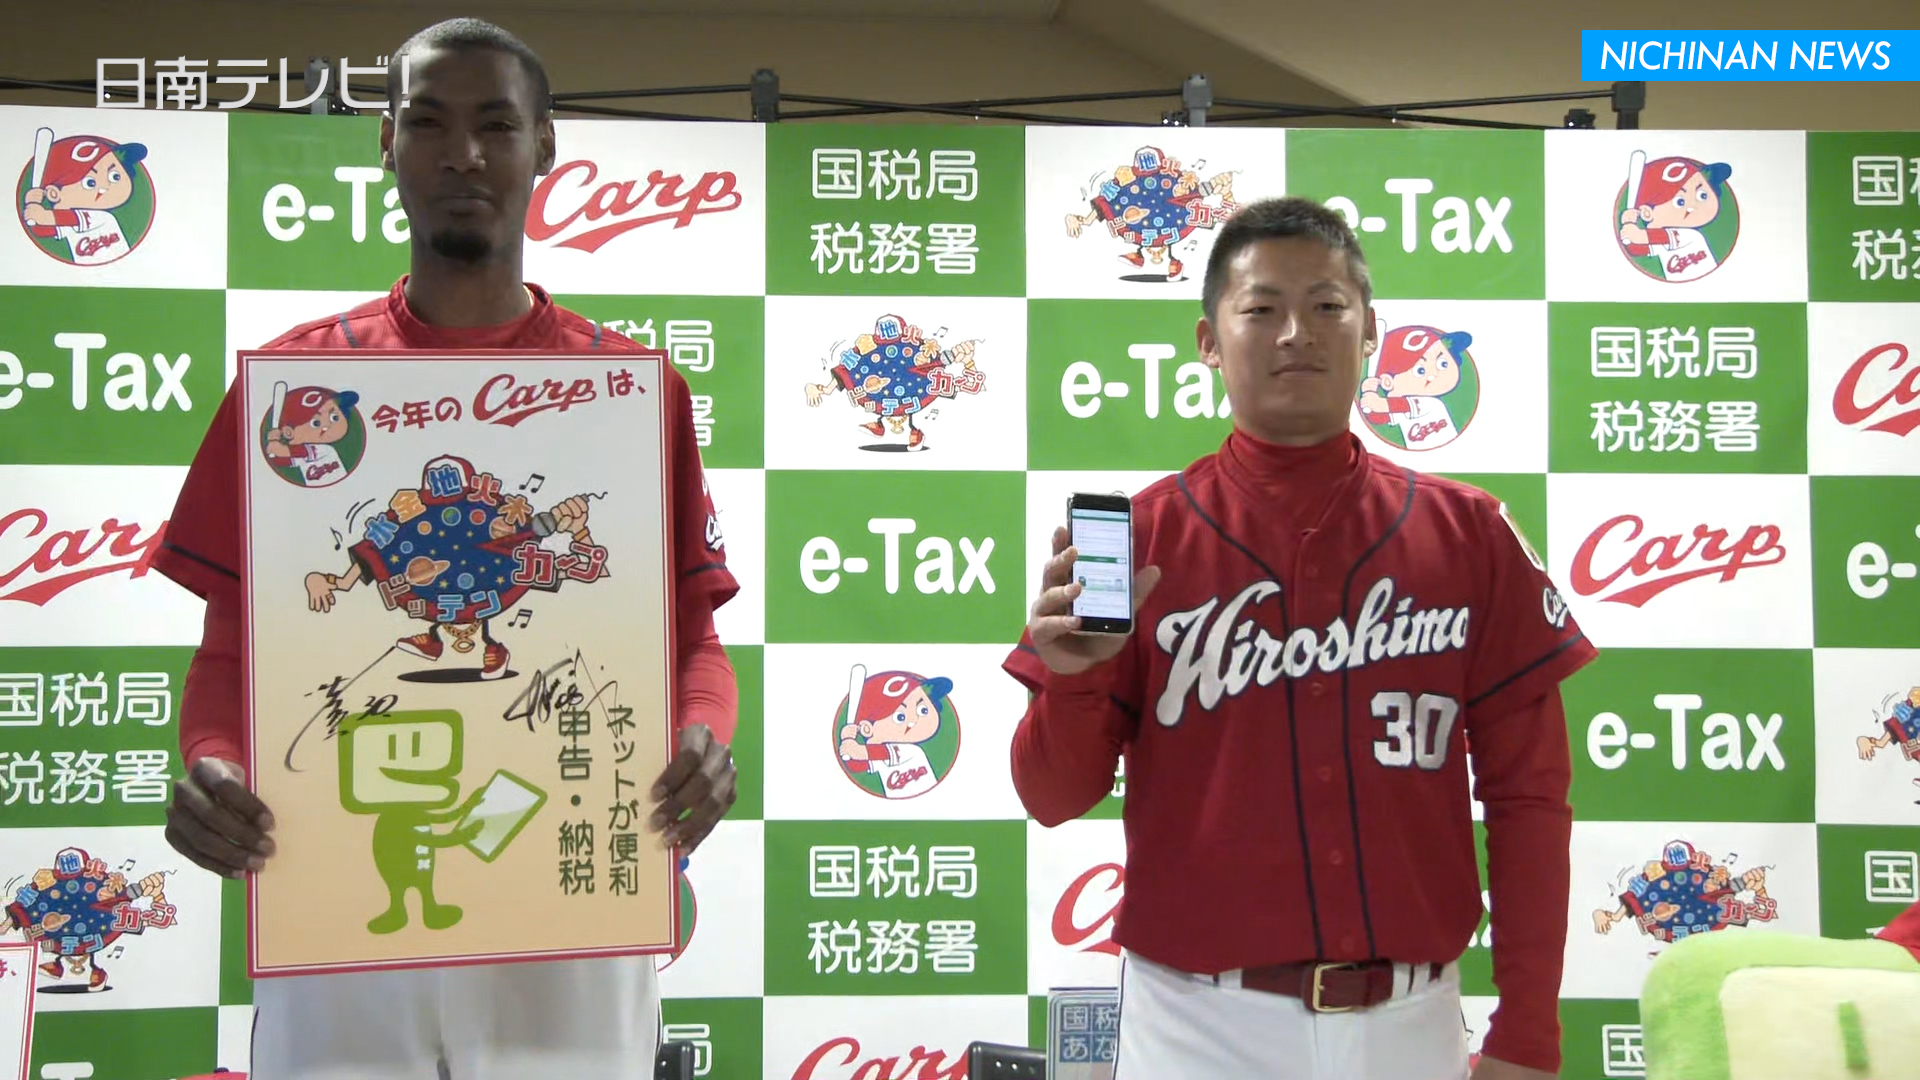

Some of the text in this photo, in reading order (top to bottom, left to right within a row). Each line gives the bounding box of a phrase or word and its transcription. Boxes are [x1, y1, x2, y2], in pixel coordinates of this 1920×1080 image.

[262, 166, 411, 244] e-Ta
[524, 159, 743, 254] Carp
[811, 148, 979, 202] 国税局
[809, 222, 980, 275] 税務署
[0, 332, 192, 412] e-Tax
[1590, 326, 1758, 379] 国税局
[371, 397, 462, 433] 今年の
[472, 374, 597, 427] Carp
[1590, 399, 1761, 453] 税務署
[511, 542, 609, 586] カープ
[800, 518, 996, 595] e-Tax
[1569, 514, 1786, 608] Carp
[1846, 523, 1920, 600] e-
[0, 671, 172, 727] 国税局
[1370, 692, 1459, 770] 30
[1586, 694, 1785, 771] e-Tax
[0, 749, 172, 805] 税務署
[557, 707, 595, 896] 申告・納税
[606, 704, 639, 896] ネットが便利
[809, 845, 977, 899] 国税局
[808, 918, 978, 974] 税務署
